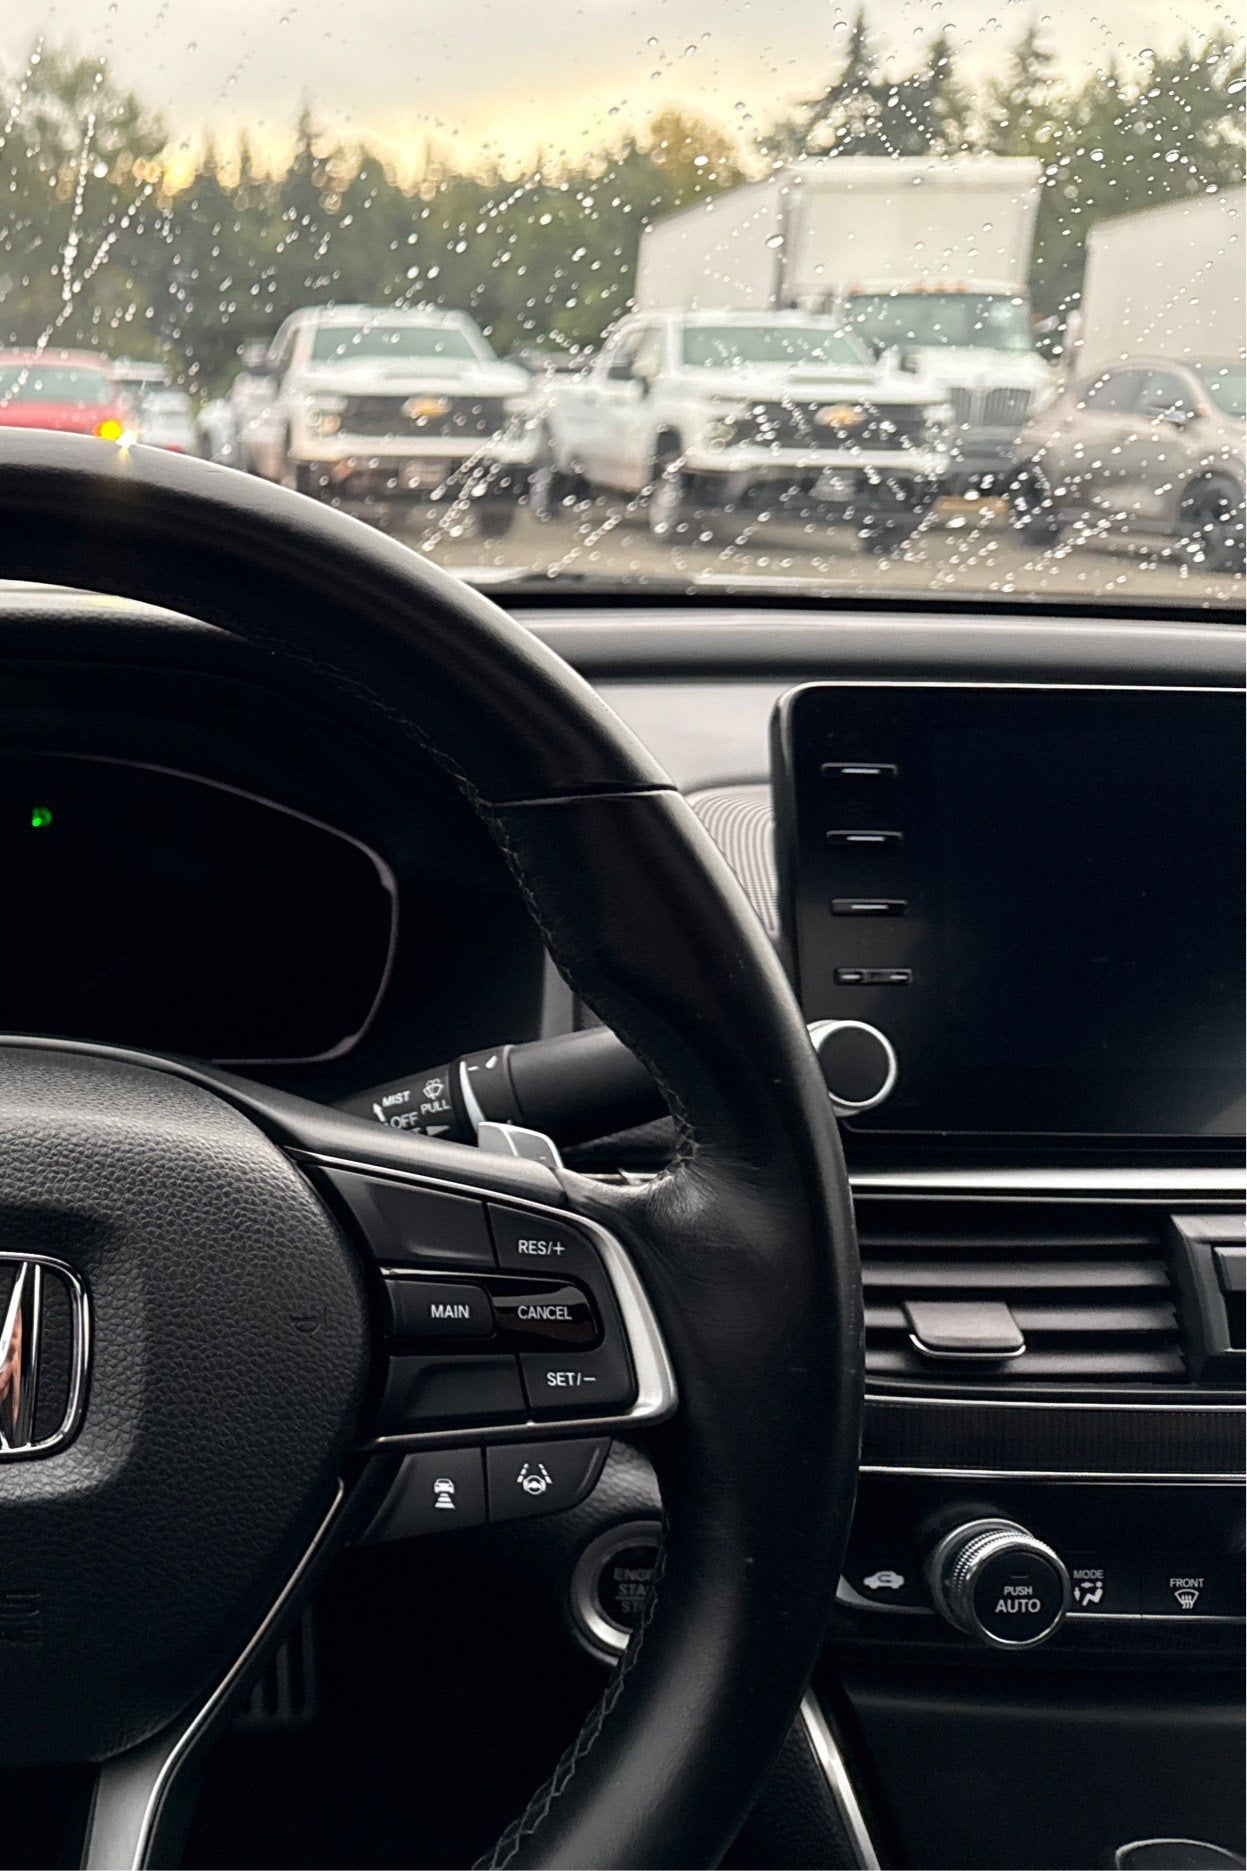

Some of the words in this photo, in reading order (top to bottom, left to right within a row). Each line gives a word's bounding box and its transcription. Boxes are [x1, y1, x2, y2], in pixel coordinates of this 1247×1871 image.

[382, 1091, 410, 1107] MIST
[420, 1099, 450, 1114] PULL
[389, 1111, 419, 1129] OFF
[517, 1239, 566, 1256] RES/+
[430, 1304, 470, 1319] MAIN
[517, 1304, 574, 1321] CANCEL
[1072, 1569, 1105, 1581] MODE
[1002, 1585, 1034, 1597] PUSH
[1169, 1578, 1205, 1589] FRONT
[994, 1598, 1041, 1615] AUTO
